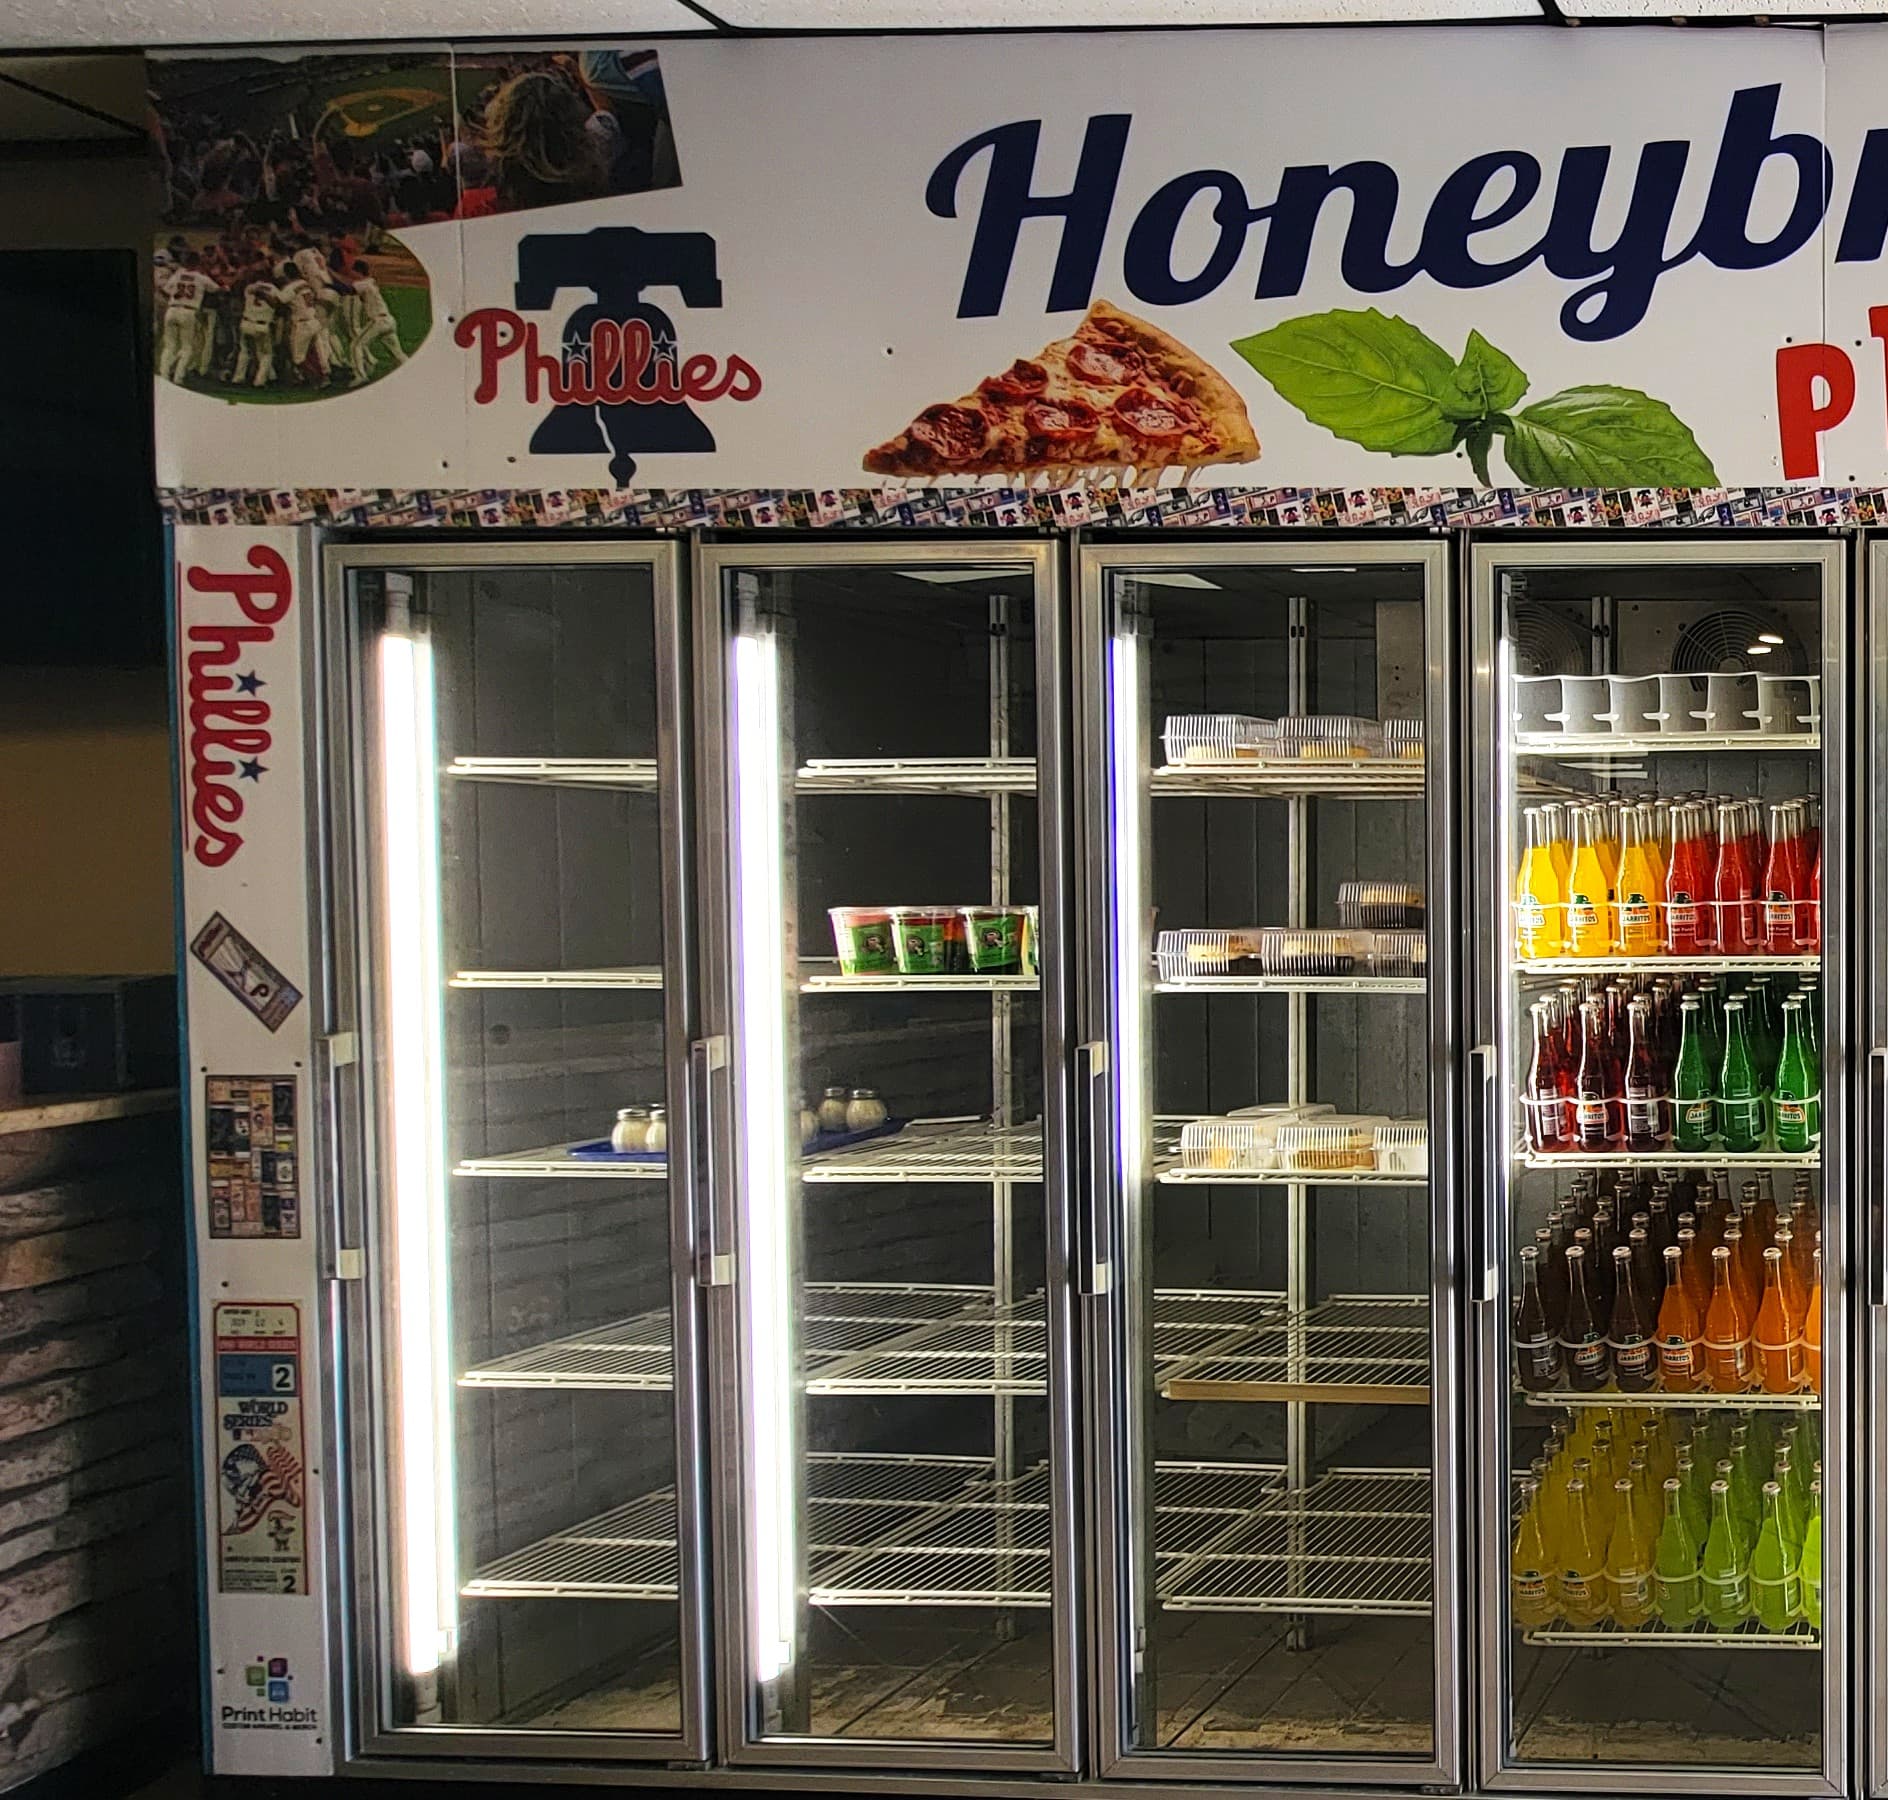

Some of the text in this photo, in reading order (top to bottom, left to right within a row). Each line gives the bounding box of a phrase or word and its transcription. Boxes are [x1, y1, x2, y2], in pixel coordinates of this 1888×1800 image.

[454, 307, 763, 406] Phillies
[187, 544, 293, 868] Phillies
[275, 1366, 291, 1388] 2
[282, 1575, 297, 1593] 2
[222, 1705, 318, 1723] Print Habit
